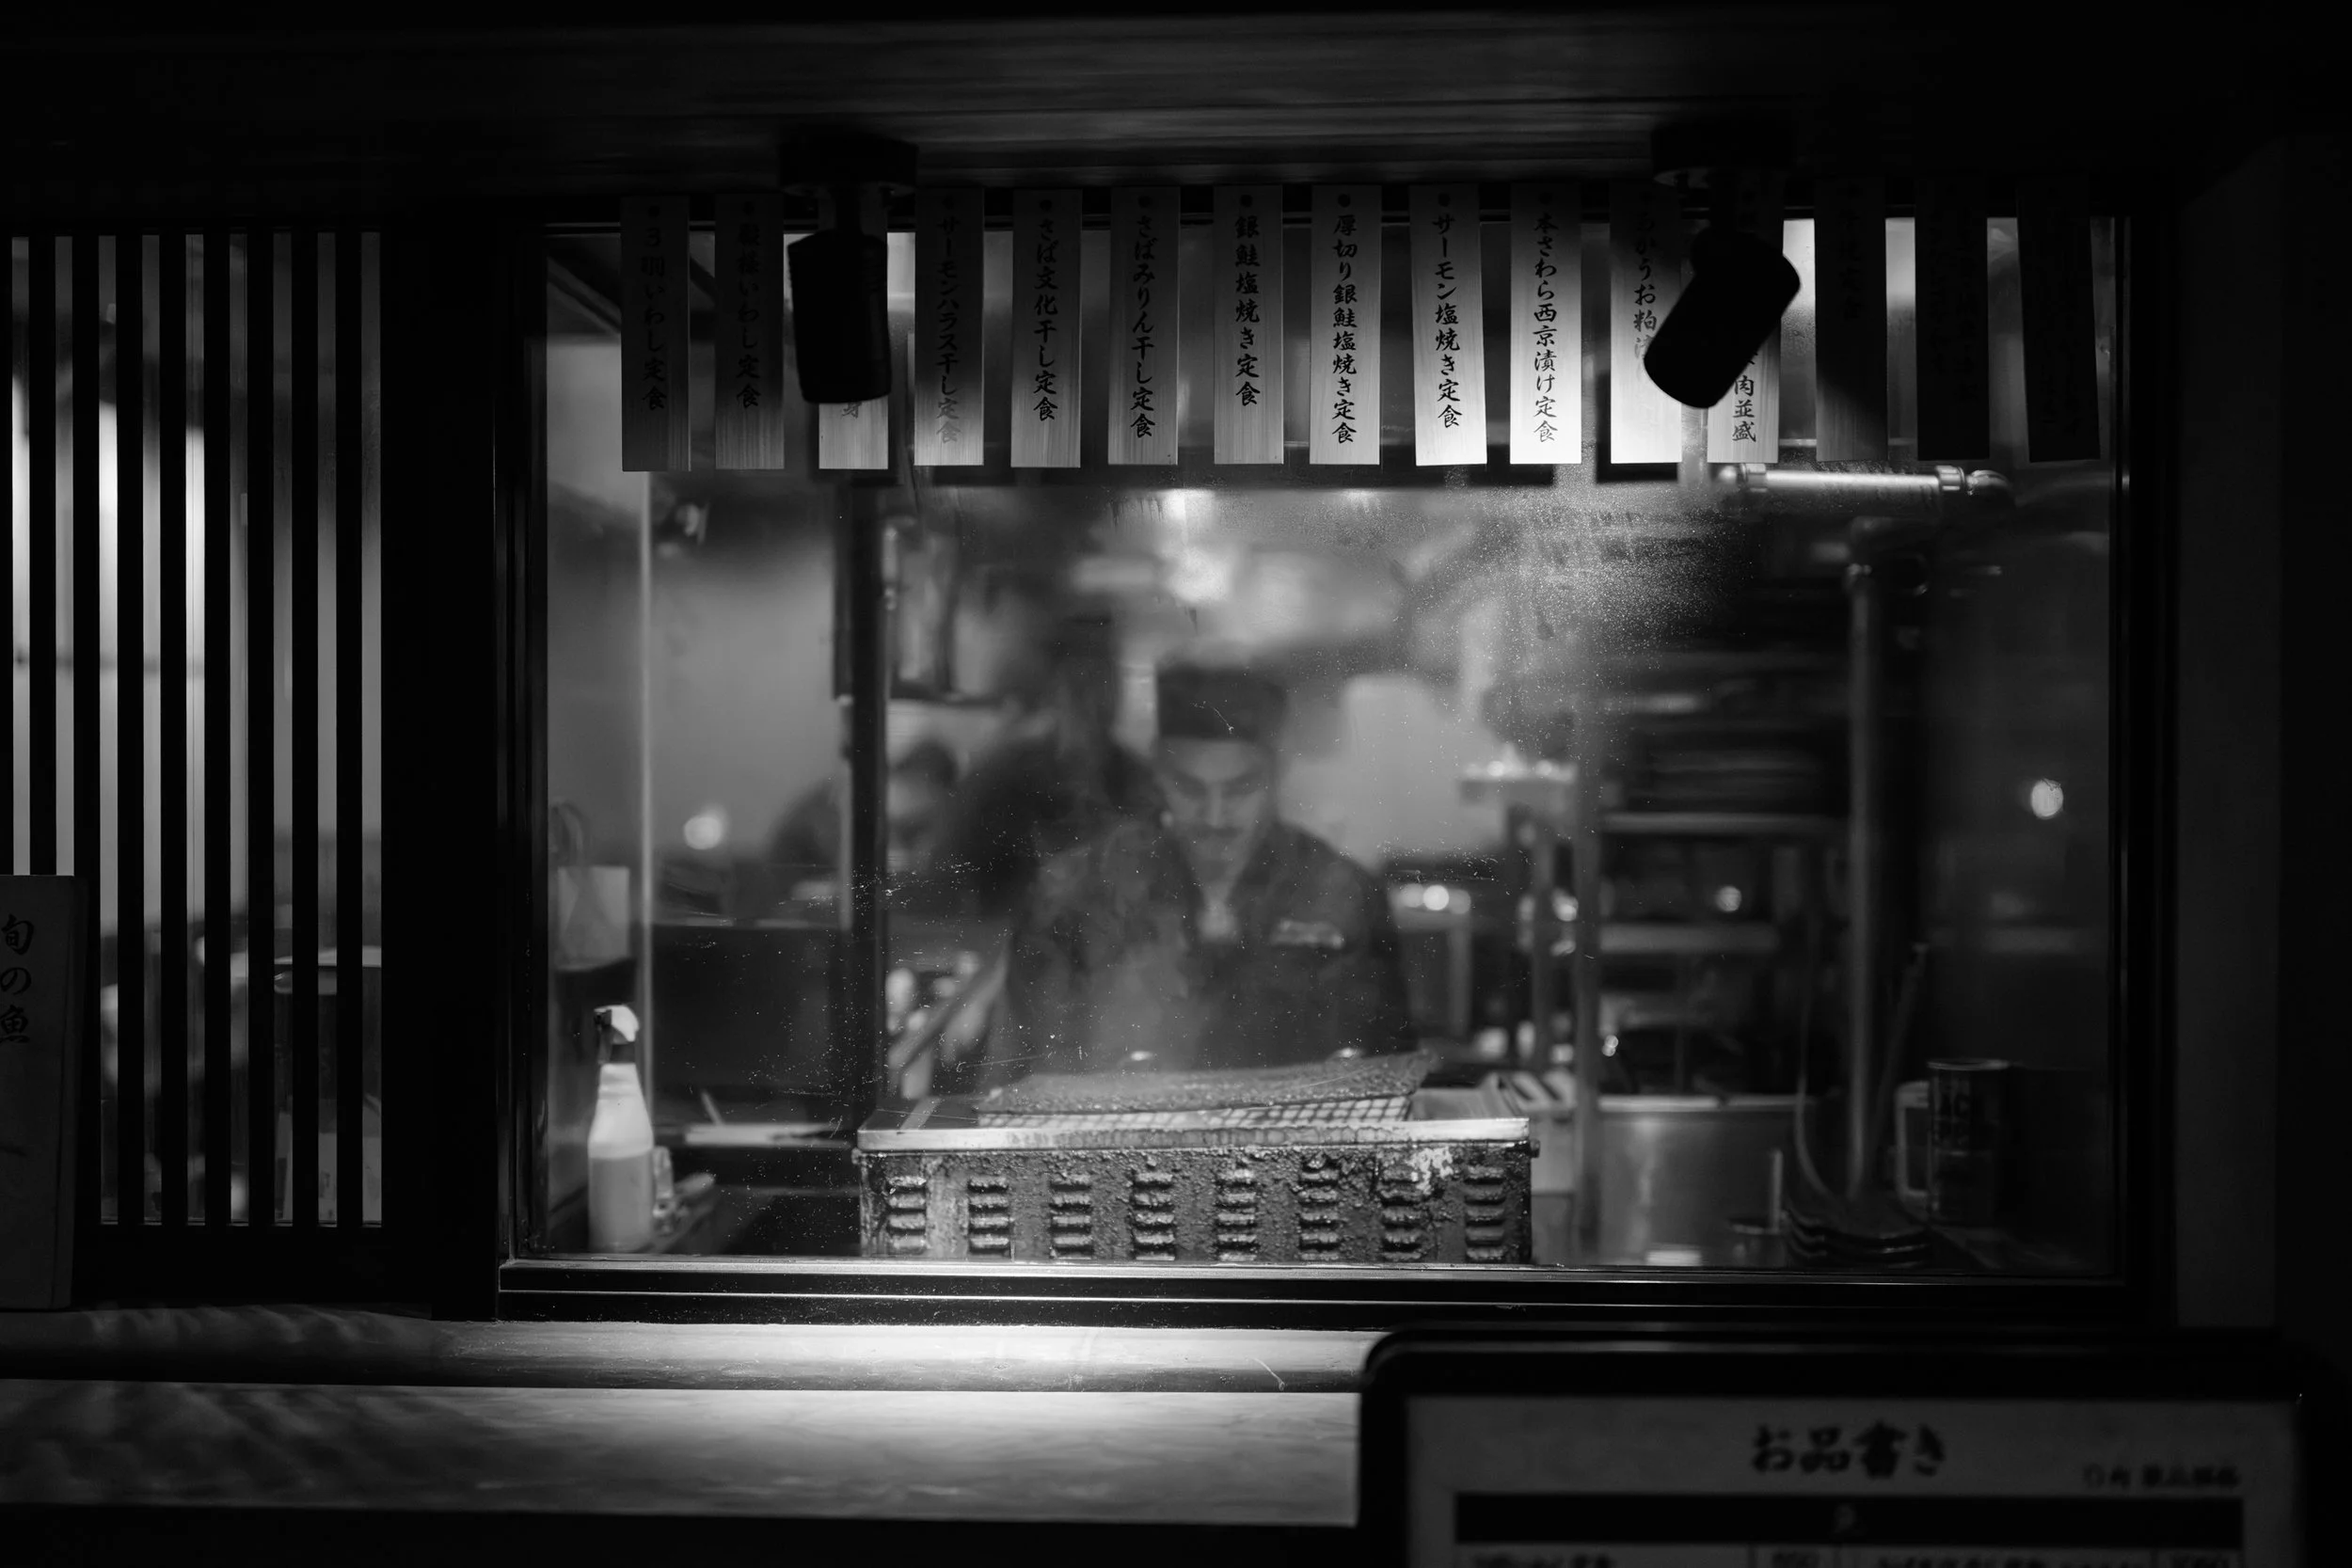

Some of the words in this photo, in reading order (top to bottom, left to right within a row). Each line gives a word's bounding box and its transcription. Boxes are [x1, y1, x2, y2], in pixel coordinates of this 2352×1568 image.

[936, 216, 961, 444] サーモンハラス干し定食
[1034, 217, 1058, 421] さば文化干し定食
[1130, 215, 1155, 438] さばみりん干し定食
[1235, 215, 1261, 406] 銀鮭塩焼き定食
[1331, 214, 1358, 444] 厚切り銀鮭塩焼き定食
[1432, 214, 1463, 428] サーモン塩焼き定食
[1533, 213, 1559, 443] 本さわら西京漬け定食
[1732, 351, 1757, 443] 肉並盛
[0, 913, 35, 1044] 旬の魚
[1752, 1418, 1946, 1480] お品書き
